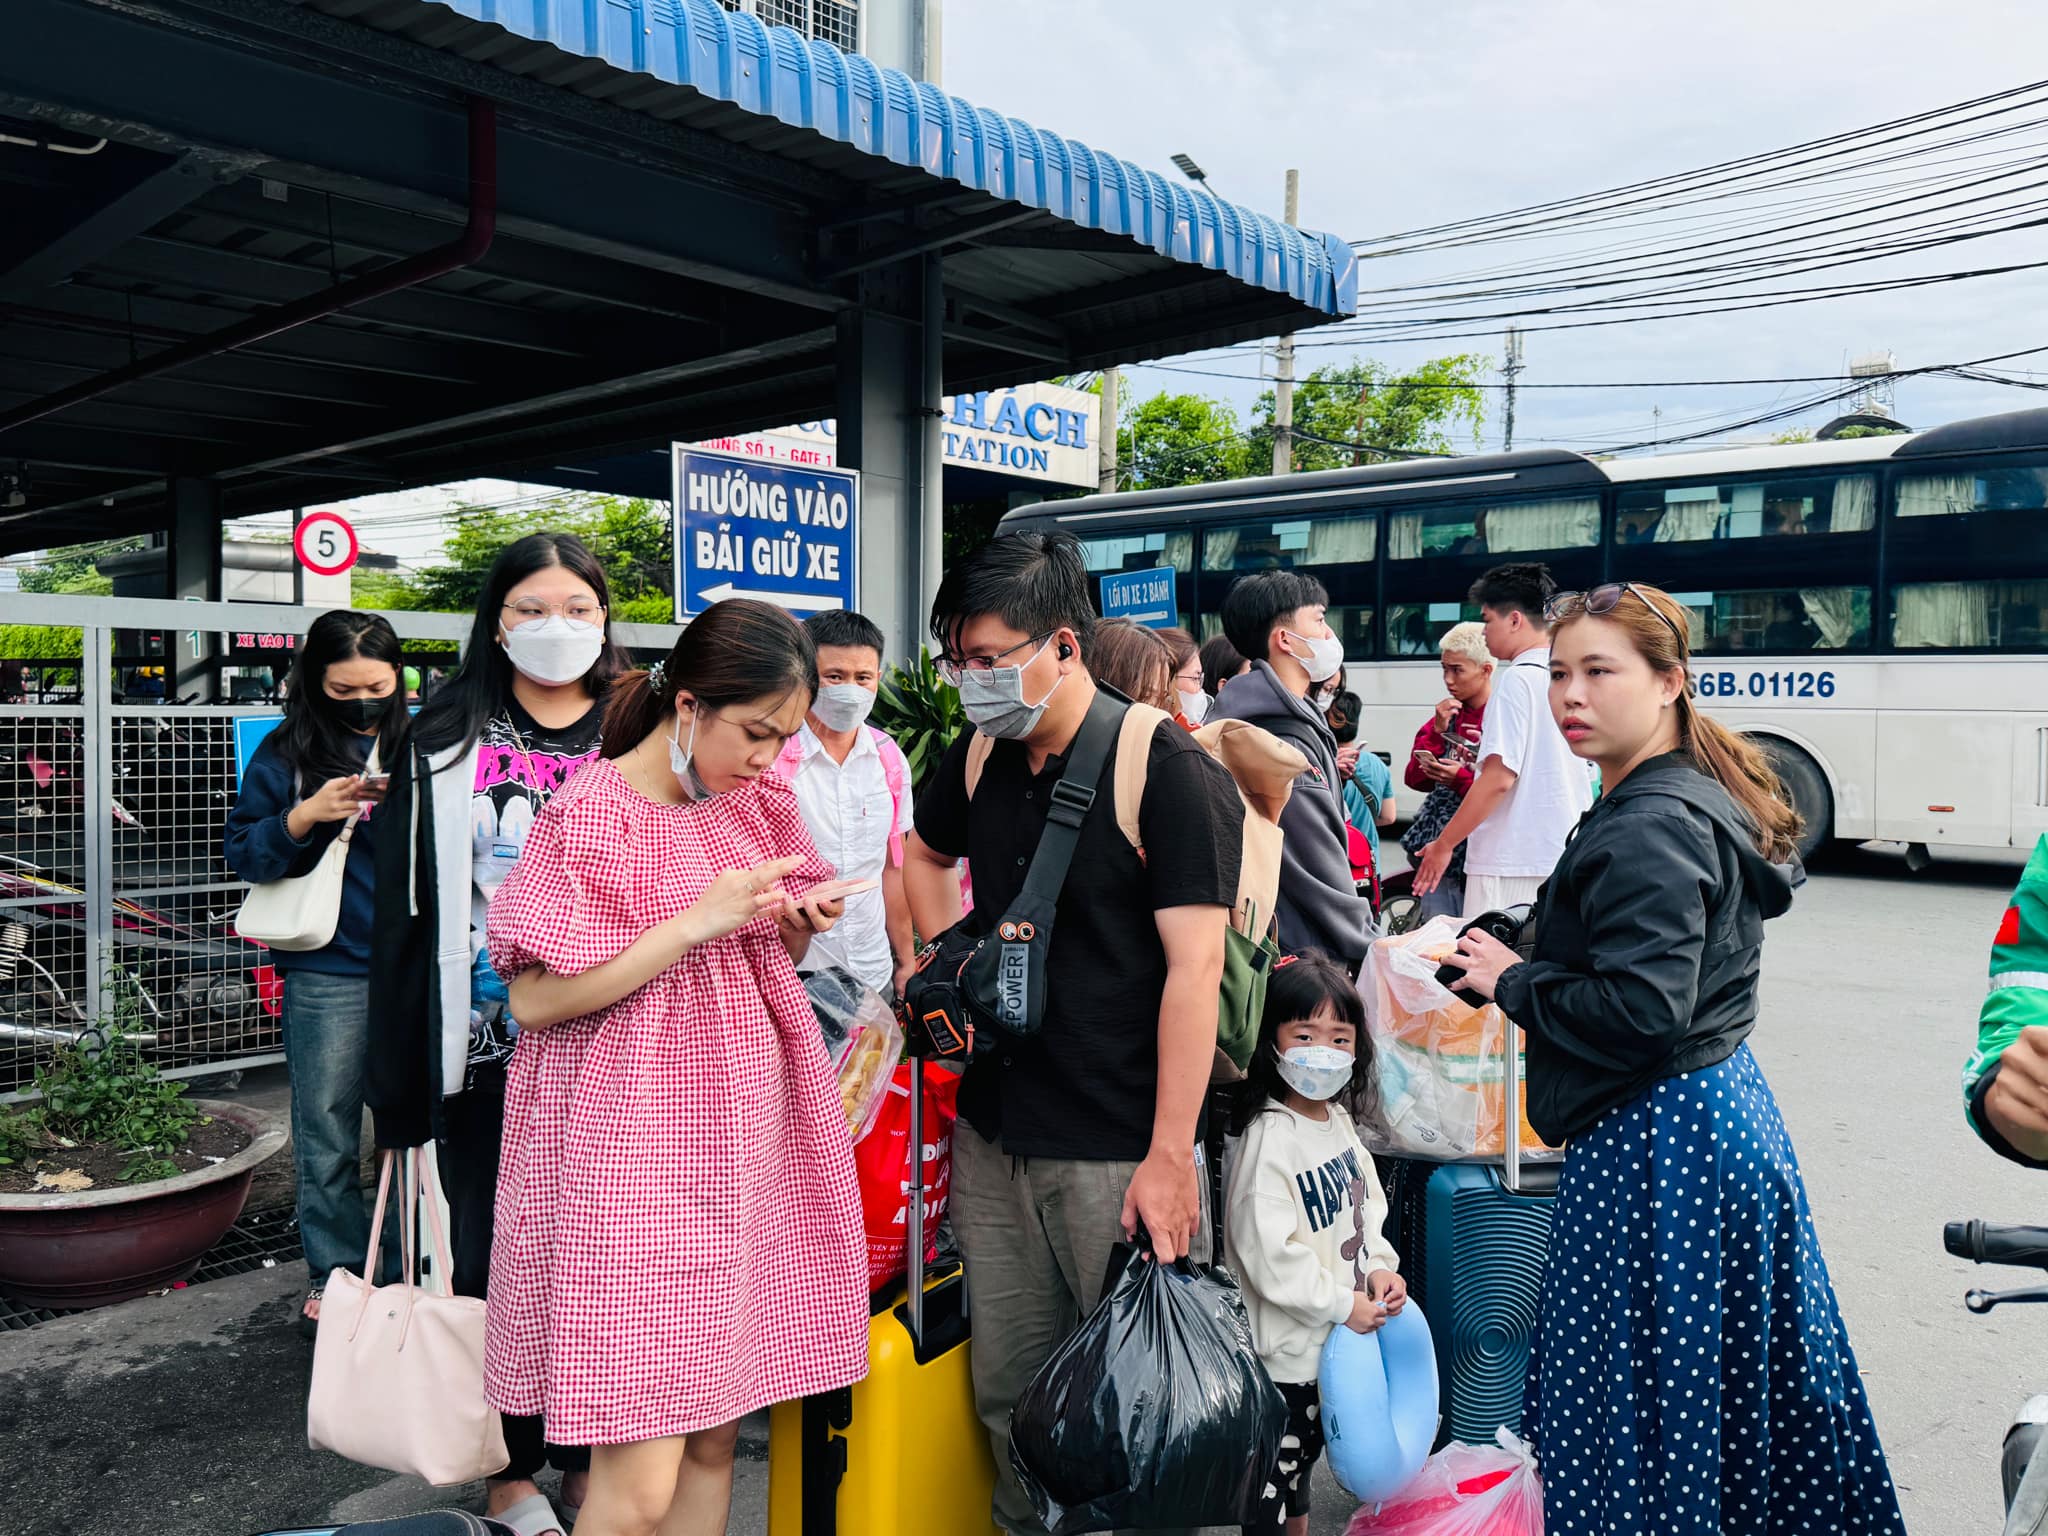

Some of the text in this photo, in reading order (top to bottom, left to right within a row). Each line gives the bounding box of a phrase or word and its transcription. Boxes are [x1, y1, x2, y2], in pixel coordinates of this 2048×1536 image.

[942, 388, 1089, 449] HÁCH
[791, 449, 821, 465] GATE
[689, 469, 848, 530] HƯỚNG VÀO
[317, 530, 336, 558] 5
[696, 523, 840, 581] BÃI GIỮ XE
[1131, 584, 1141, 606] XE
[1142, 583, 1148, 604] 2
[1149, 575, 1170, 603] BÁNH
[236, 634, 256, 649] XE
